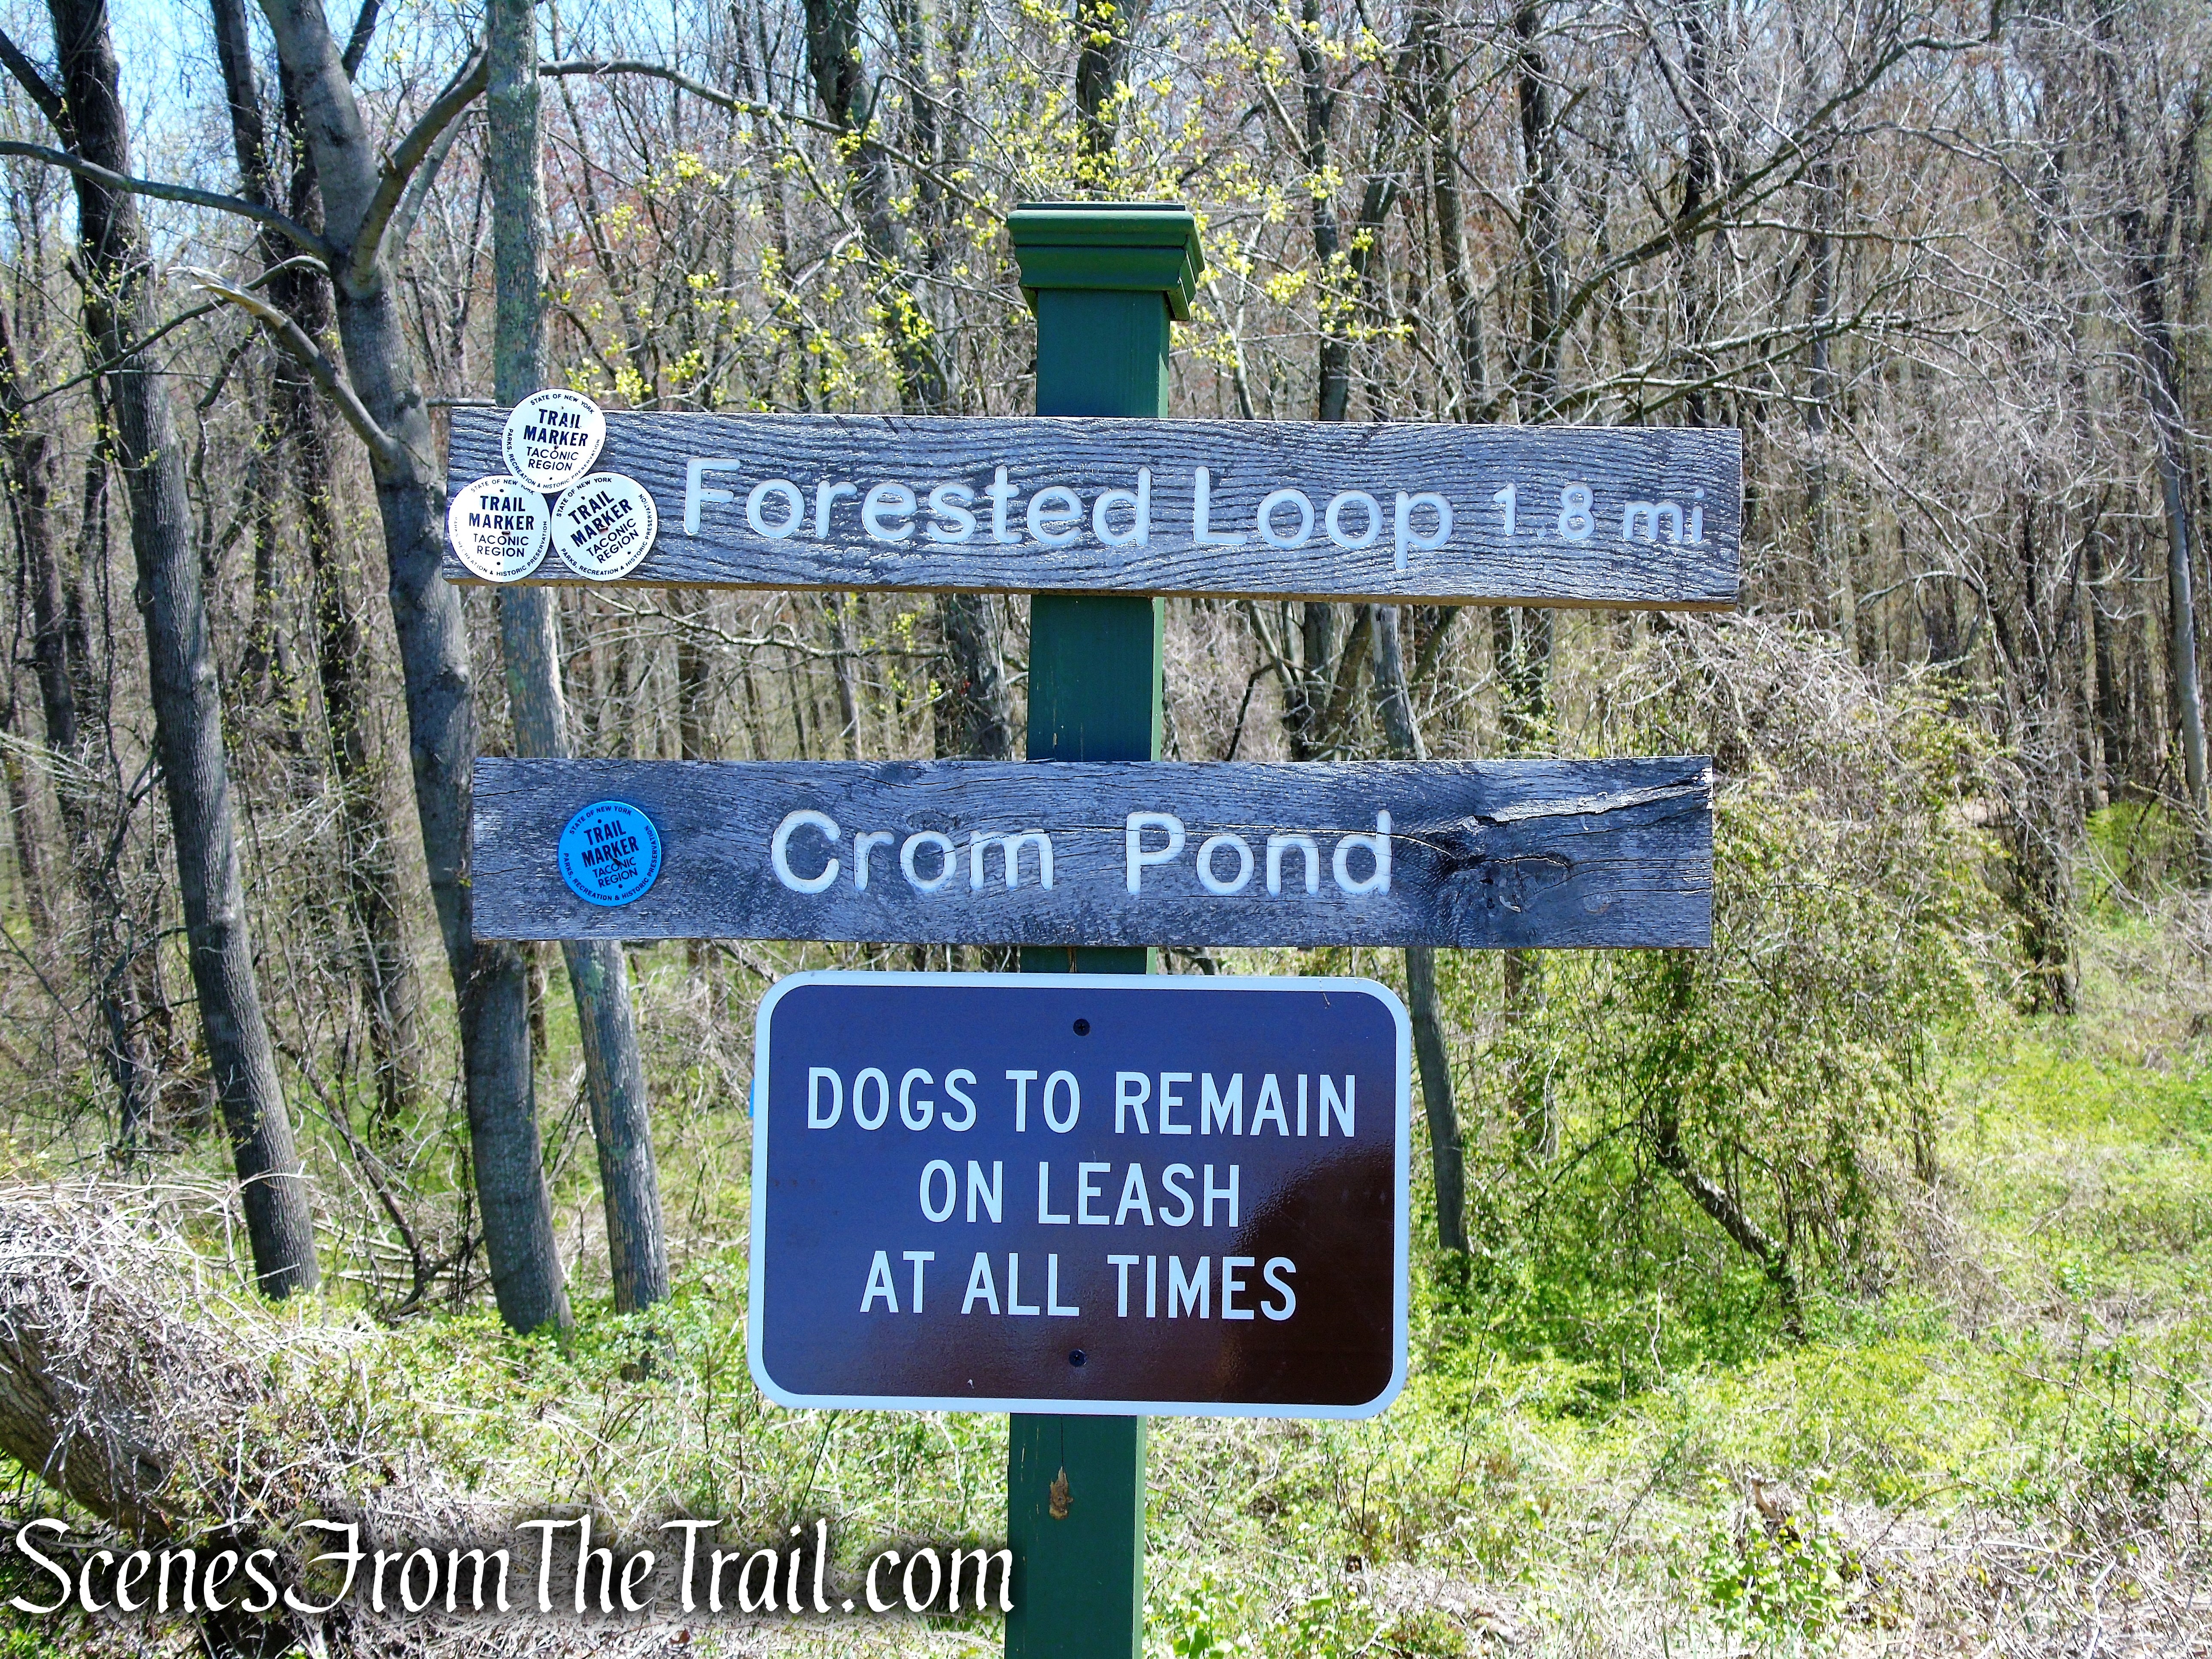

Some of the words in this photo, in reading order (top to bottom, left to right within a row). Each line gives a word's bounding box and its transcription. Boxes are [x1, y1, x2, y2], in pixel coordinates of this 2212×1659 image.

[530, 395, 550, 405] STATE
[581, 401, 595, 414] YORK
[539, 408, 582, 429] TRAIL
[523, 425, 588, 447] MARKER
[526, 446, 579, 460] TACONIC
[528, 459, 572, 471] REGION
[471, 481, 489, 492] STATE
[508, 453, 536, 486] RECREATION
[543, 478, 570, 489] HISTORIC
[480, 495, 526, 512] TRAIL
[556, 498, 568, 517] STATE
[568, 489, 575, 497] OF
[577, 480, 590, 490] NEW
[568, 490, 614, 525] TRAIL
[684, 457, 1152, 547] Forested
[1193, 465, 1454, 570] Loop
[1492, 482, 1595, 541] 1.8
[1623, 487, 1705, 544] mi
[469, 513, 534, 530] MARKER
[561, 548, 577, 568] PARKS,
[579, 565, 619, 575] RECREATION
[626, 541, 647, 567] HISTORIC
[638, 493, 653, 540] PRESERVATION
[570, 499, 633, 547] MARKER
[586, 518, 636, 556] TACONIC
[474, 533, 529, 546] TACONIC
[477, 546, 524, 557] REGION
[496, 565, 527, 576] HISTORIC
[527, 521, 547, 567] PRESERVATION
[596, 529, 639, 564] REGION
[569, 815, 586, 835] STATE
[586, 809, 594, 818] OF
[614, 806, 632, 816] YORK
[583, 820, 626, 846] TRAIL
[563, 853, 574, 878] PARKS,
[572, 878, 612, 901] RECREATION
[622, 878, 649, 899] HISTORIC
[644, 825, 657, 877] PRESERVATION
[581, 836, 640, 868] MARKER
[592, 857, 636, 878] TACONIC
[771, 809, 1054, 895] Crom
[1126, 809, 1393, 896] Pond
[598, 867, 638, 888] REGION
[807, 1067, 977, 1132] DOGS
[1006, 1070, 1080, 1134] TO
[1115, 1072, 1356, 1138] REMAIN
[919, 1160, 1003, 1224] ON
[1038, 1162, 1240, 1228] LEASH
[860, 1250, 935, 1314] AT
[961, 1252, 1080, 1317] ALL
[1107, 1255, 1297, 1321] TIMES
